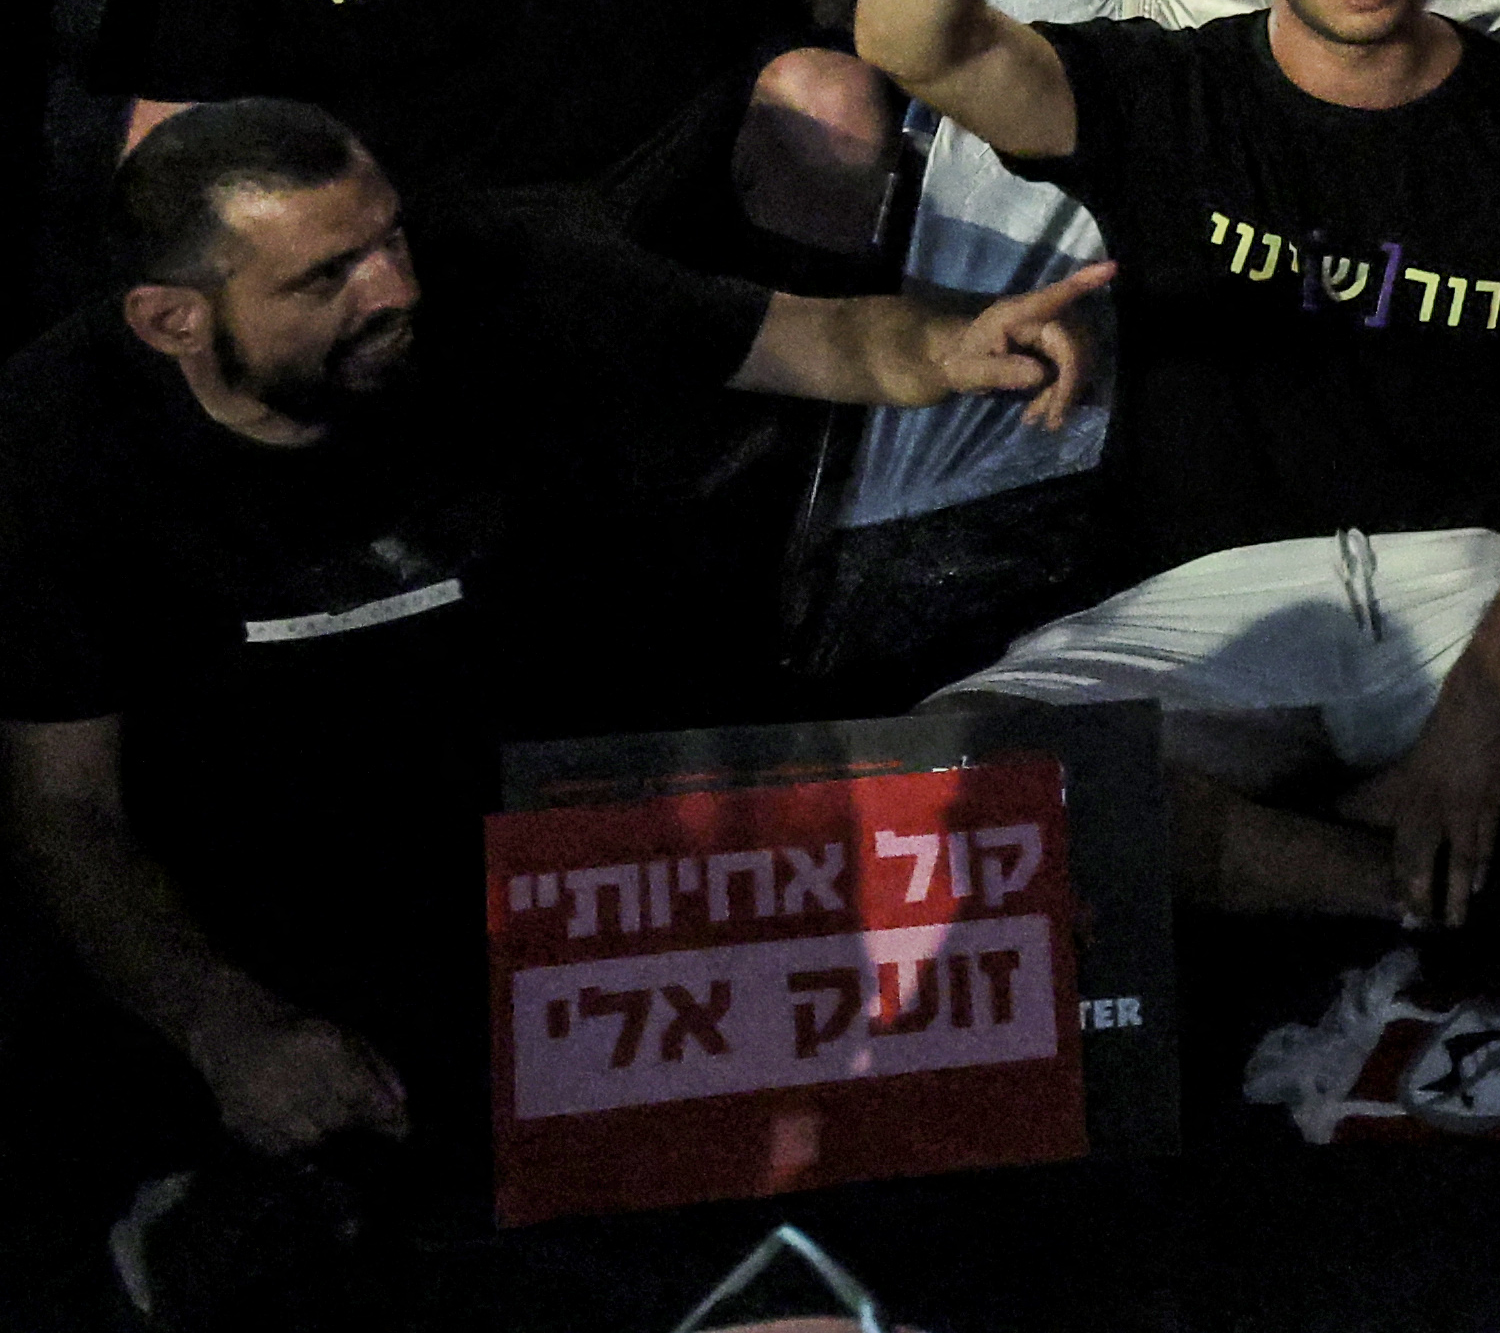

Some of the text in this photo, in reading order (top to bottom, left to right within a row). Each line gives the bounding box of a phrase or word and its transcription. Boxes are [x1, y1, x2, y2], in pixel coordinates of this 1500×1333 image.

[508, 822, 1045, 940] קול אחיותיי
[545, 949, 1020, 1070] זועק אלי
